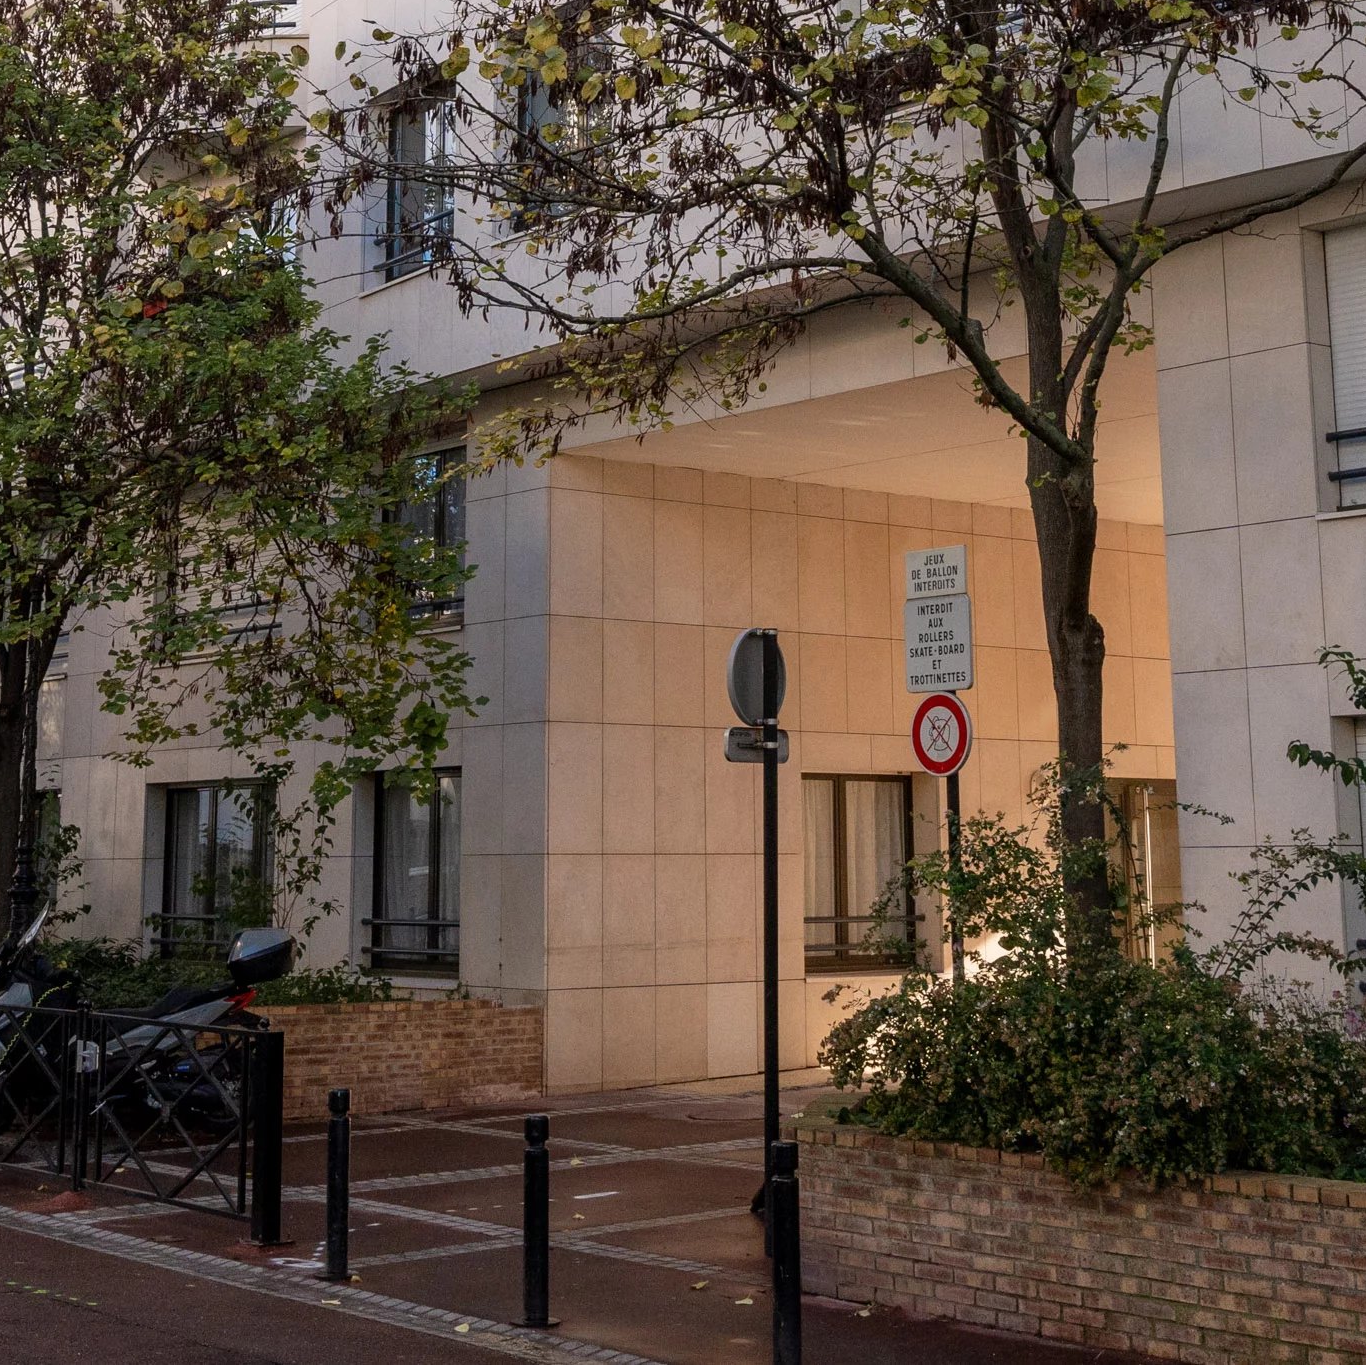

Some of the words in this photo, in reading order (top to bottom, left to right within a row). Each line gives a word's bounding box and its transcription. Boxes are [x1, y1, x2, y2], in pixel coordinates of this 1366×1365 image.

[924, 554, 944, 566] JEUX
[911, 569, 921, 580] DE
[927, 565, 958, 577] BALLON
[915, 579, 955, 592] INTERDITS
[918, 602, 953, 615] INTERDIT
[928, 618, 943, 628] AUX
[919, 631, 954, 643] ROLLERS
[932, 660, 942, 670] ET
[910, 672, 966, 686] TROTTINETTES
